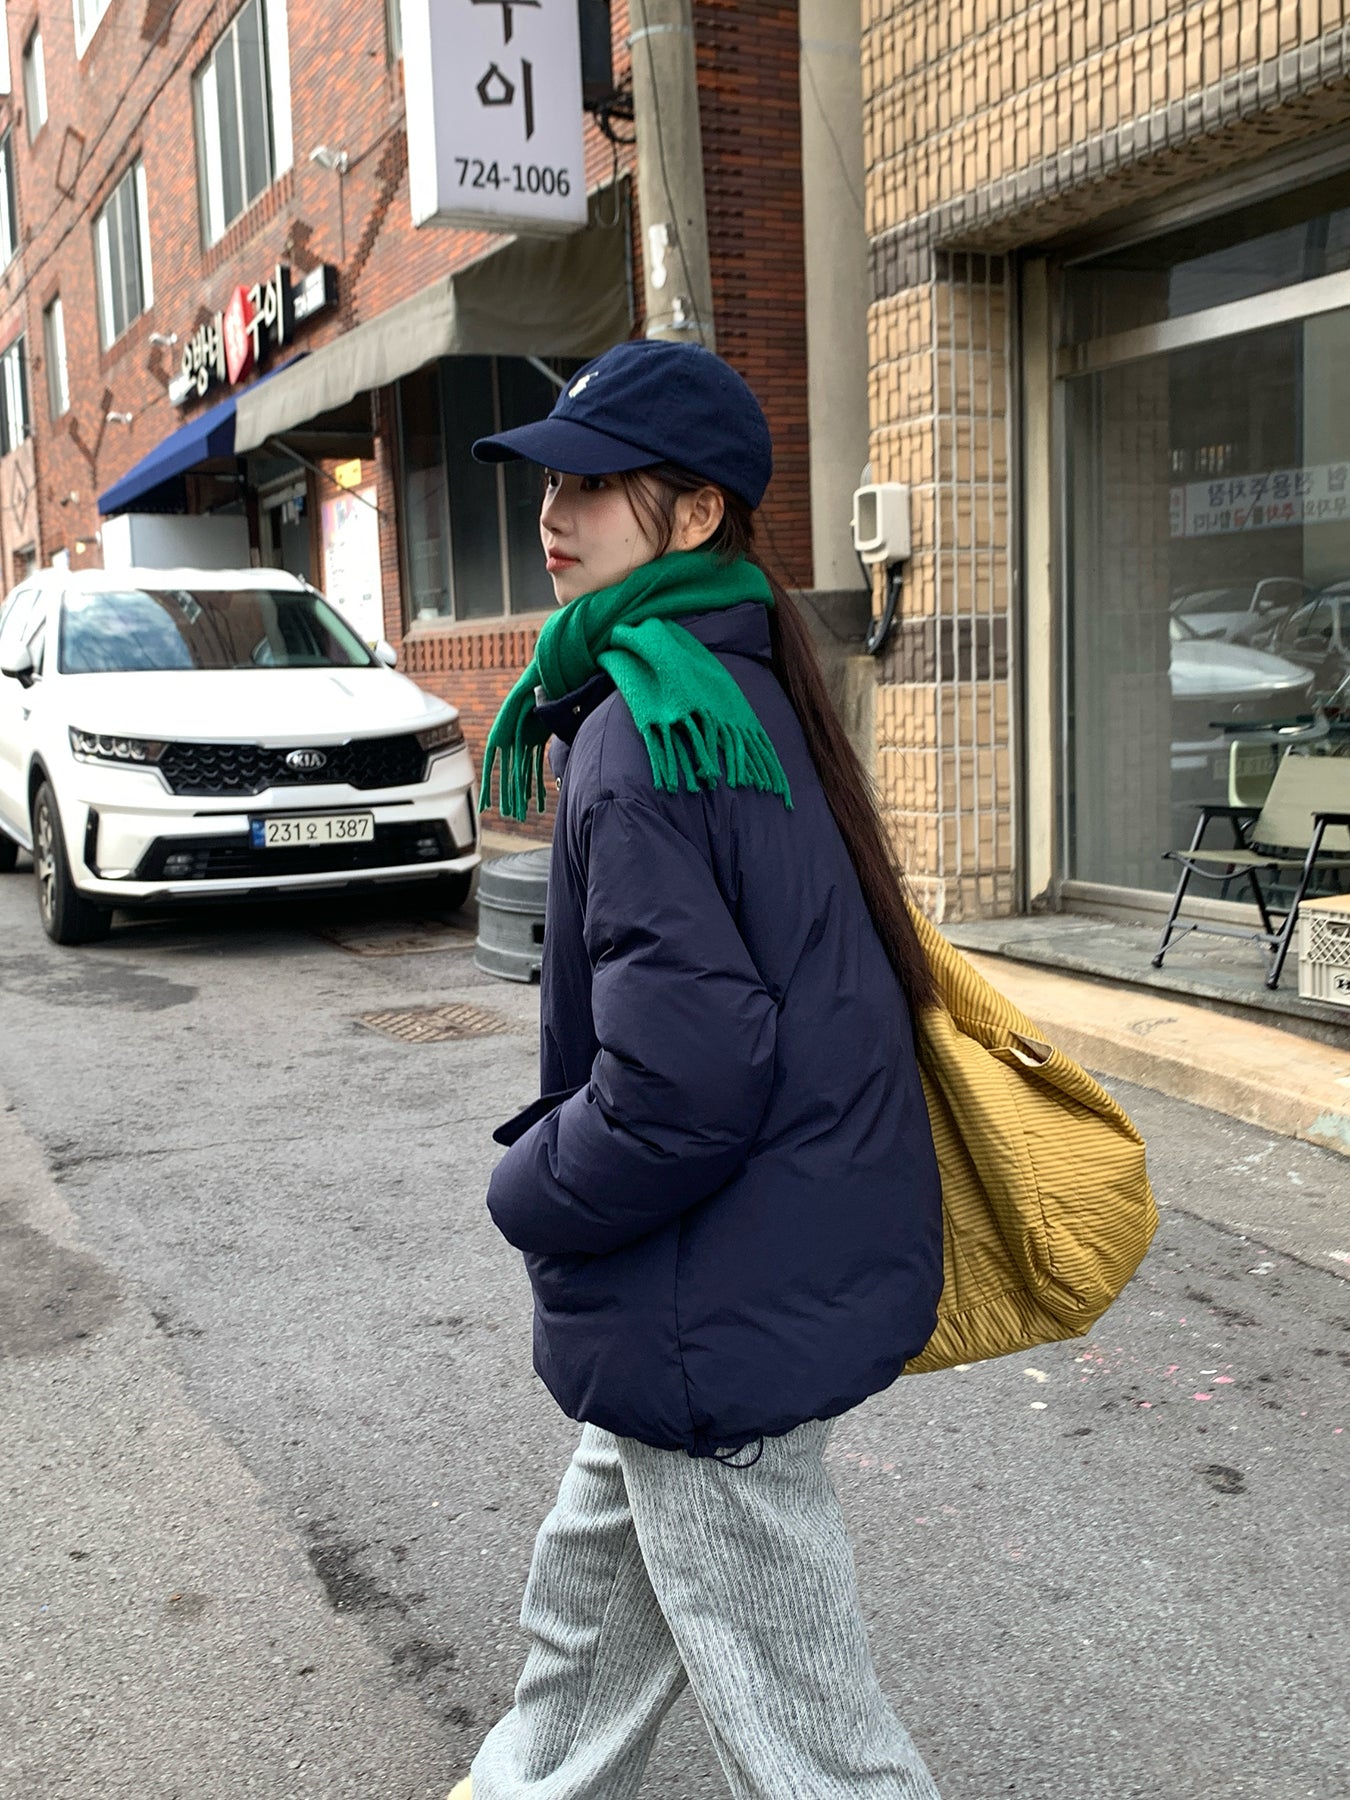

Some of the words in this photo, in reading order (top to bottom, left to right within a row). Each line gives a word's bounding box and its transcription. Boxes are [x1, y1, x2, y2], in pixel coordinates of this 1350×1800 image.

[455, 157, 570, 197] 724-1006
[247, 263, 285, 362] 구이
[293, 753, 322, 767] KIA
